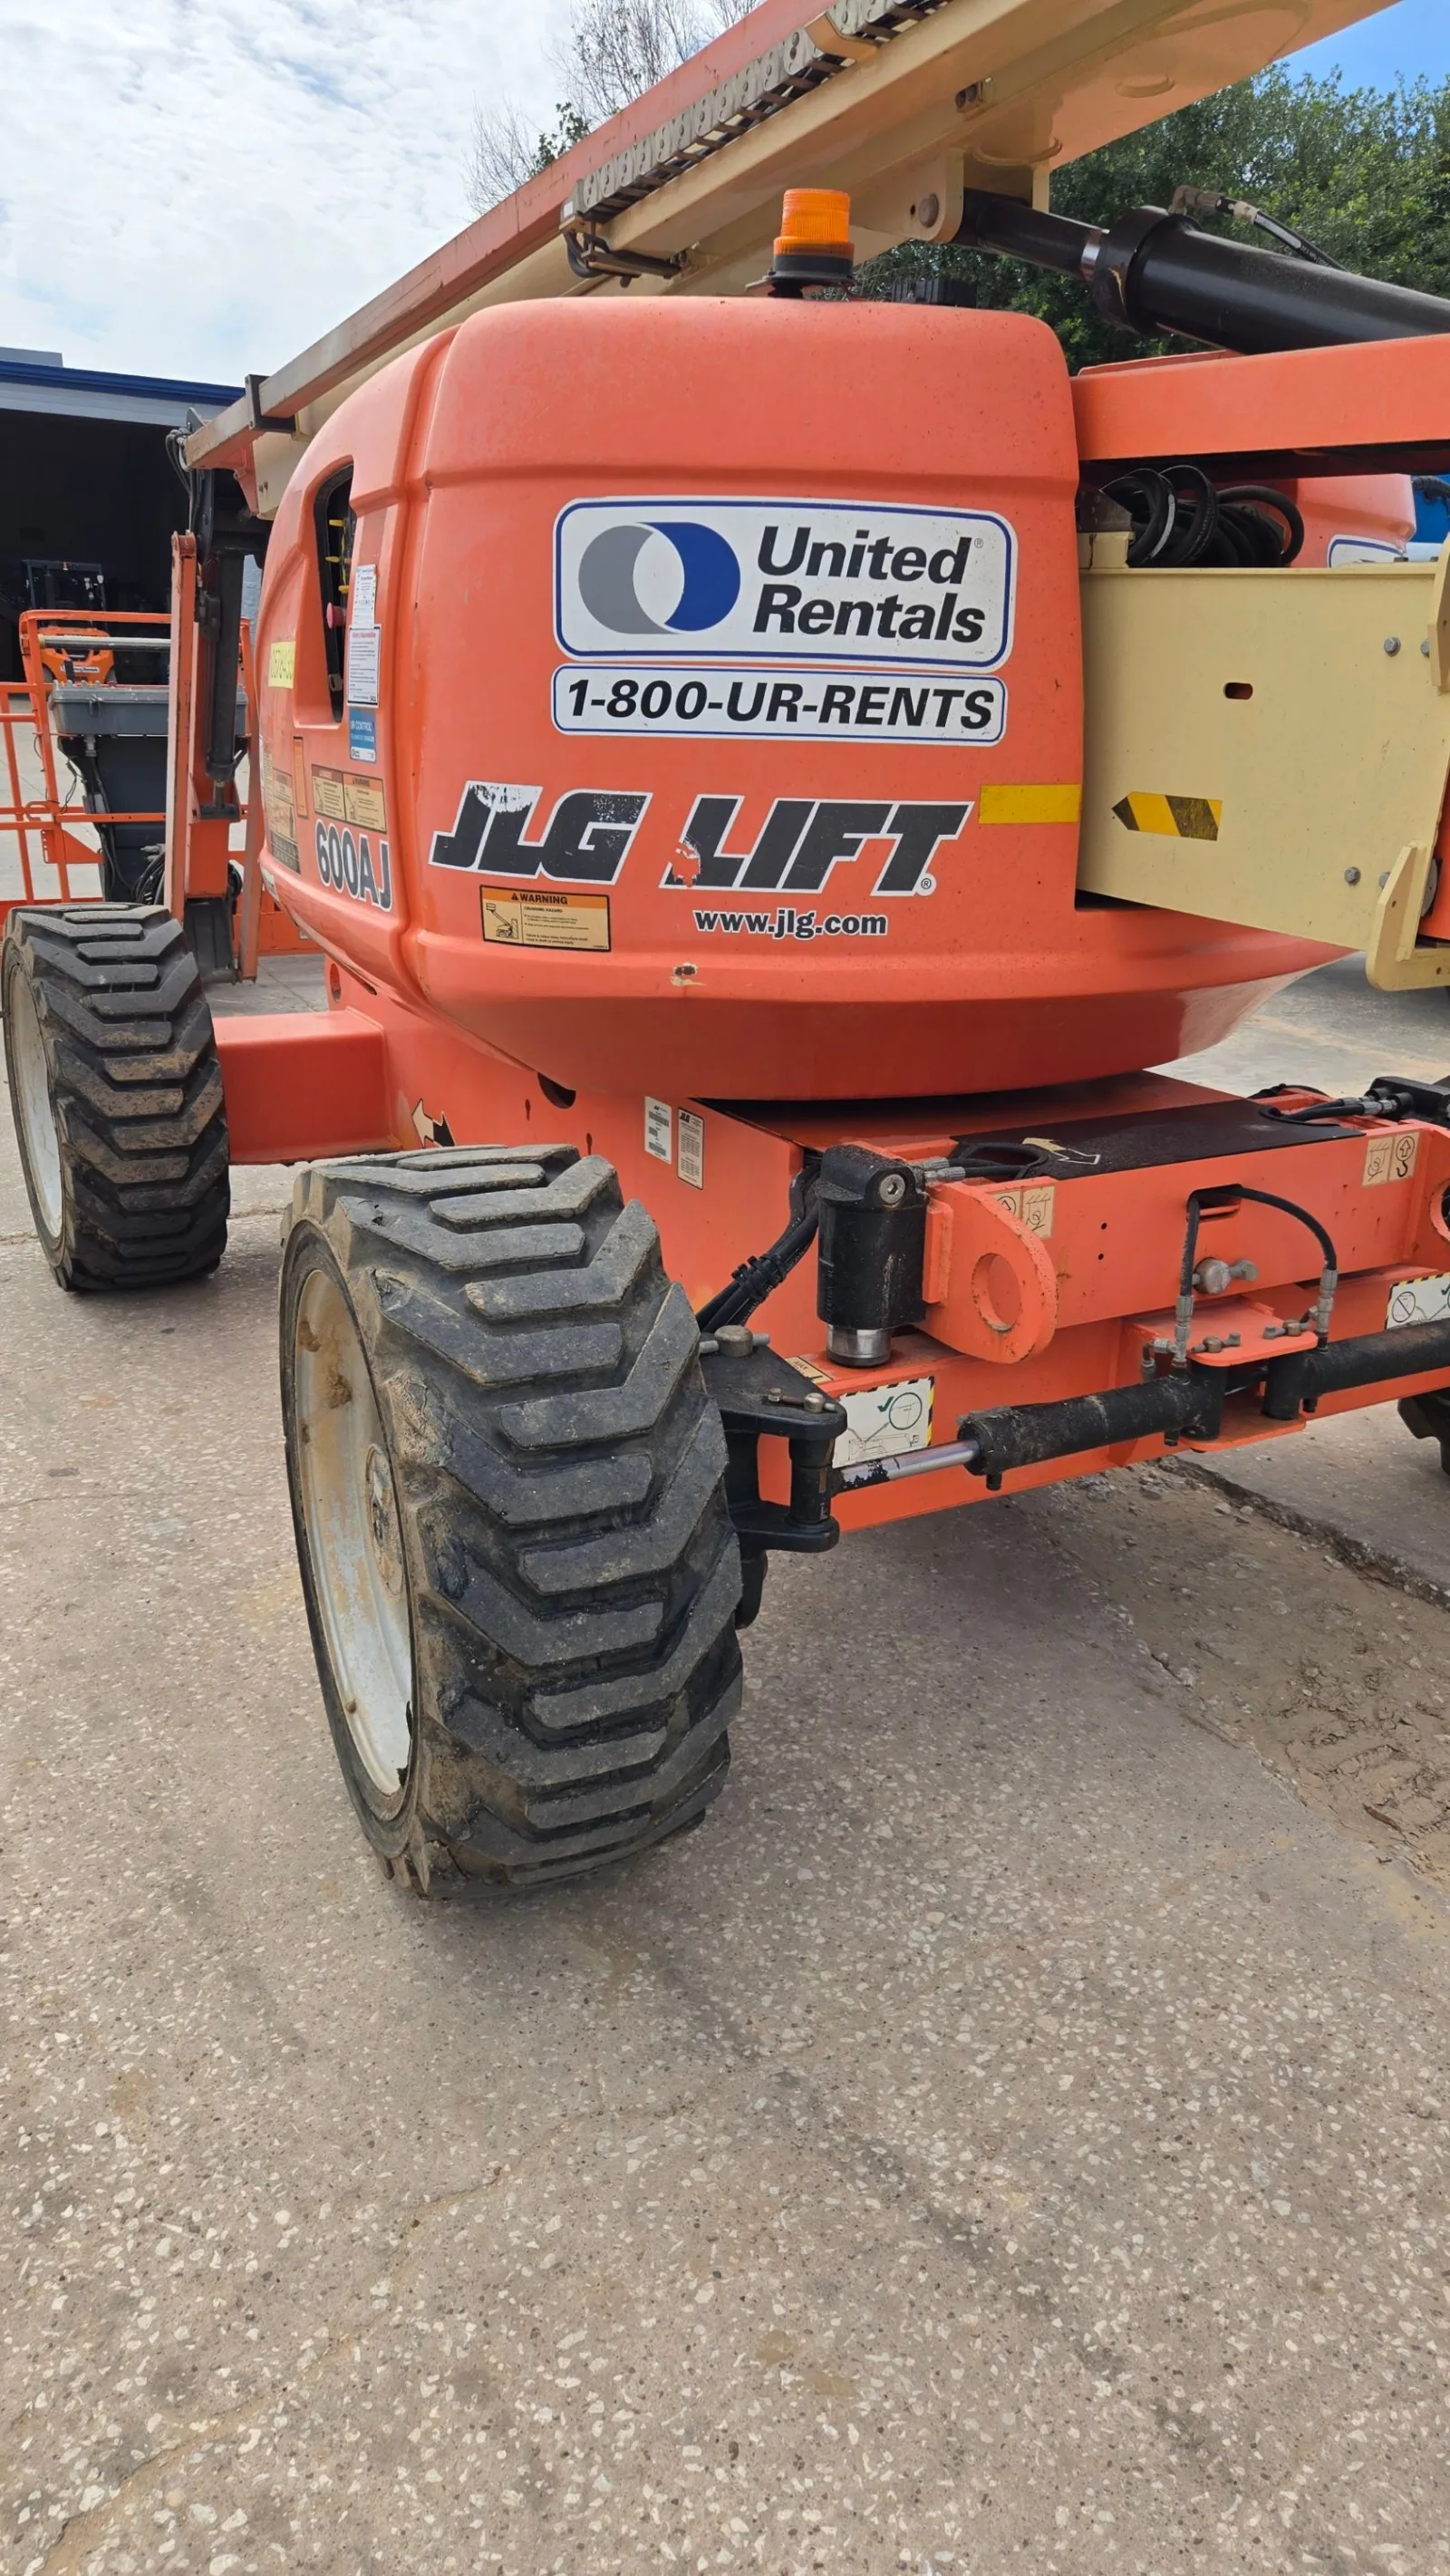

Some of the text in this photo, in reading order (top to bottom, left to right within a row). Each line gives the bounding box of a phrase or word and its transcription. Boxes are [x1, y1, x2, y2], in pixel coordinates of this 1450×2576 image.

[757, 525, 972, 586] United
[752, 583, 986, 644] Rentals
[567, 679, 994, 731] 1-800-UR-RENTS
[315, 818, 392, 912] 600AJ
[429, 780, 974, 896] JLG LIFT
[519, 893, 568, 905] WARNING
[694, 906, 887, 939] www.jlg.com
